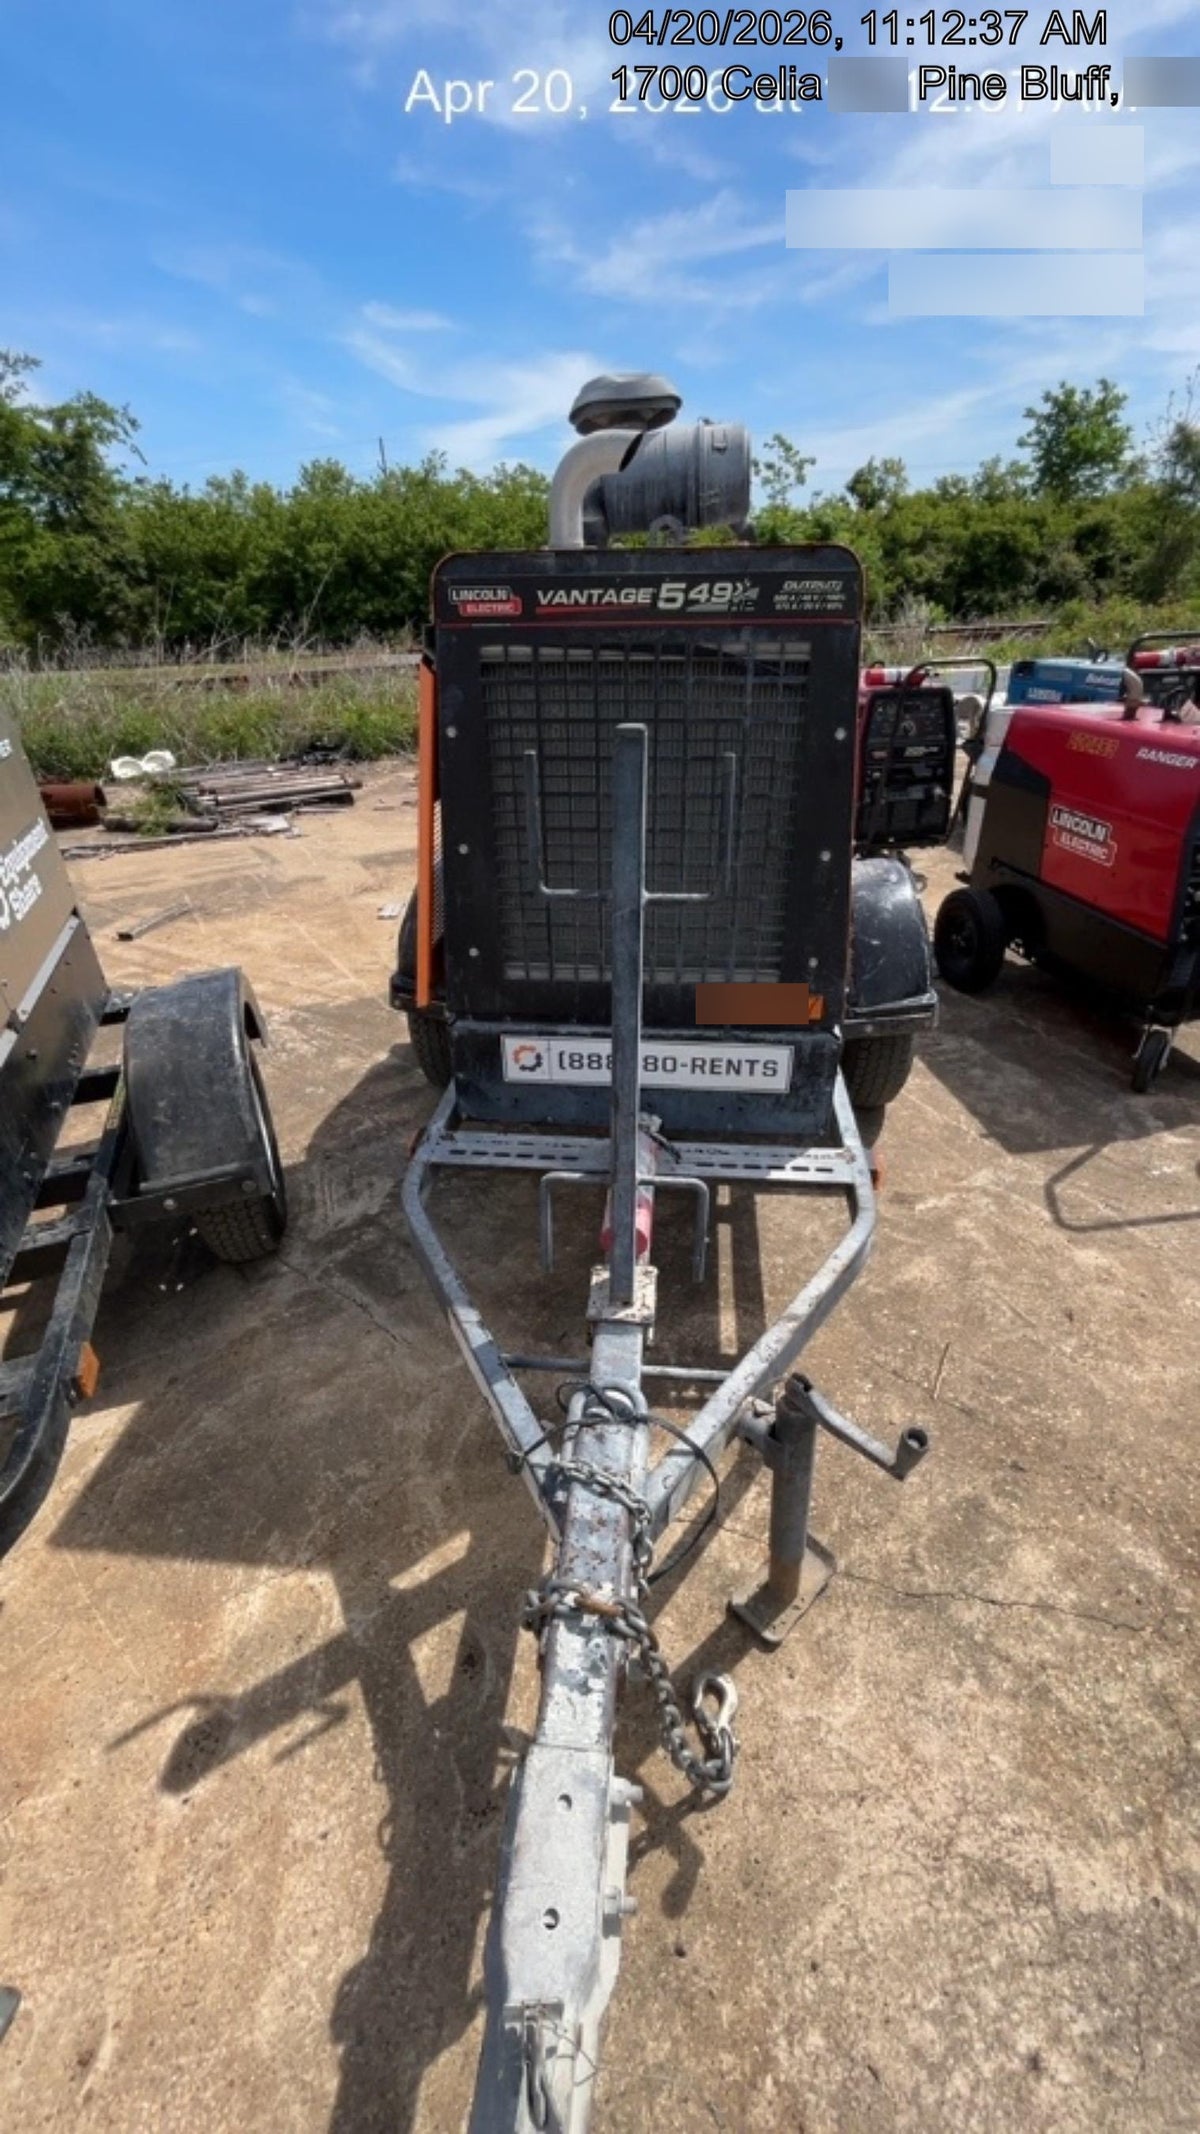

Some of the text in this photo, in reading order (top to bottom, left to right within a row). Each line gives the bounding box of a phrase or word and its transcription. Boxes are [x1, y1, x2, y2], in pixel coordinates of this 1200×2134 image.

[452, 589, 508, 601] LINCOLN
[537, 588, 654, 606] VANTAGE
[1136, 747, 1198, 769] RANGER
[1052, 808, 1108, 842] LINCOLN
[1060, 831, 1110, 860] ELECTRIC
[642, 1054, 779, 1078] 80-RENTS
